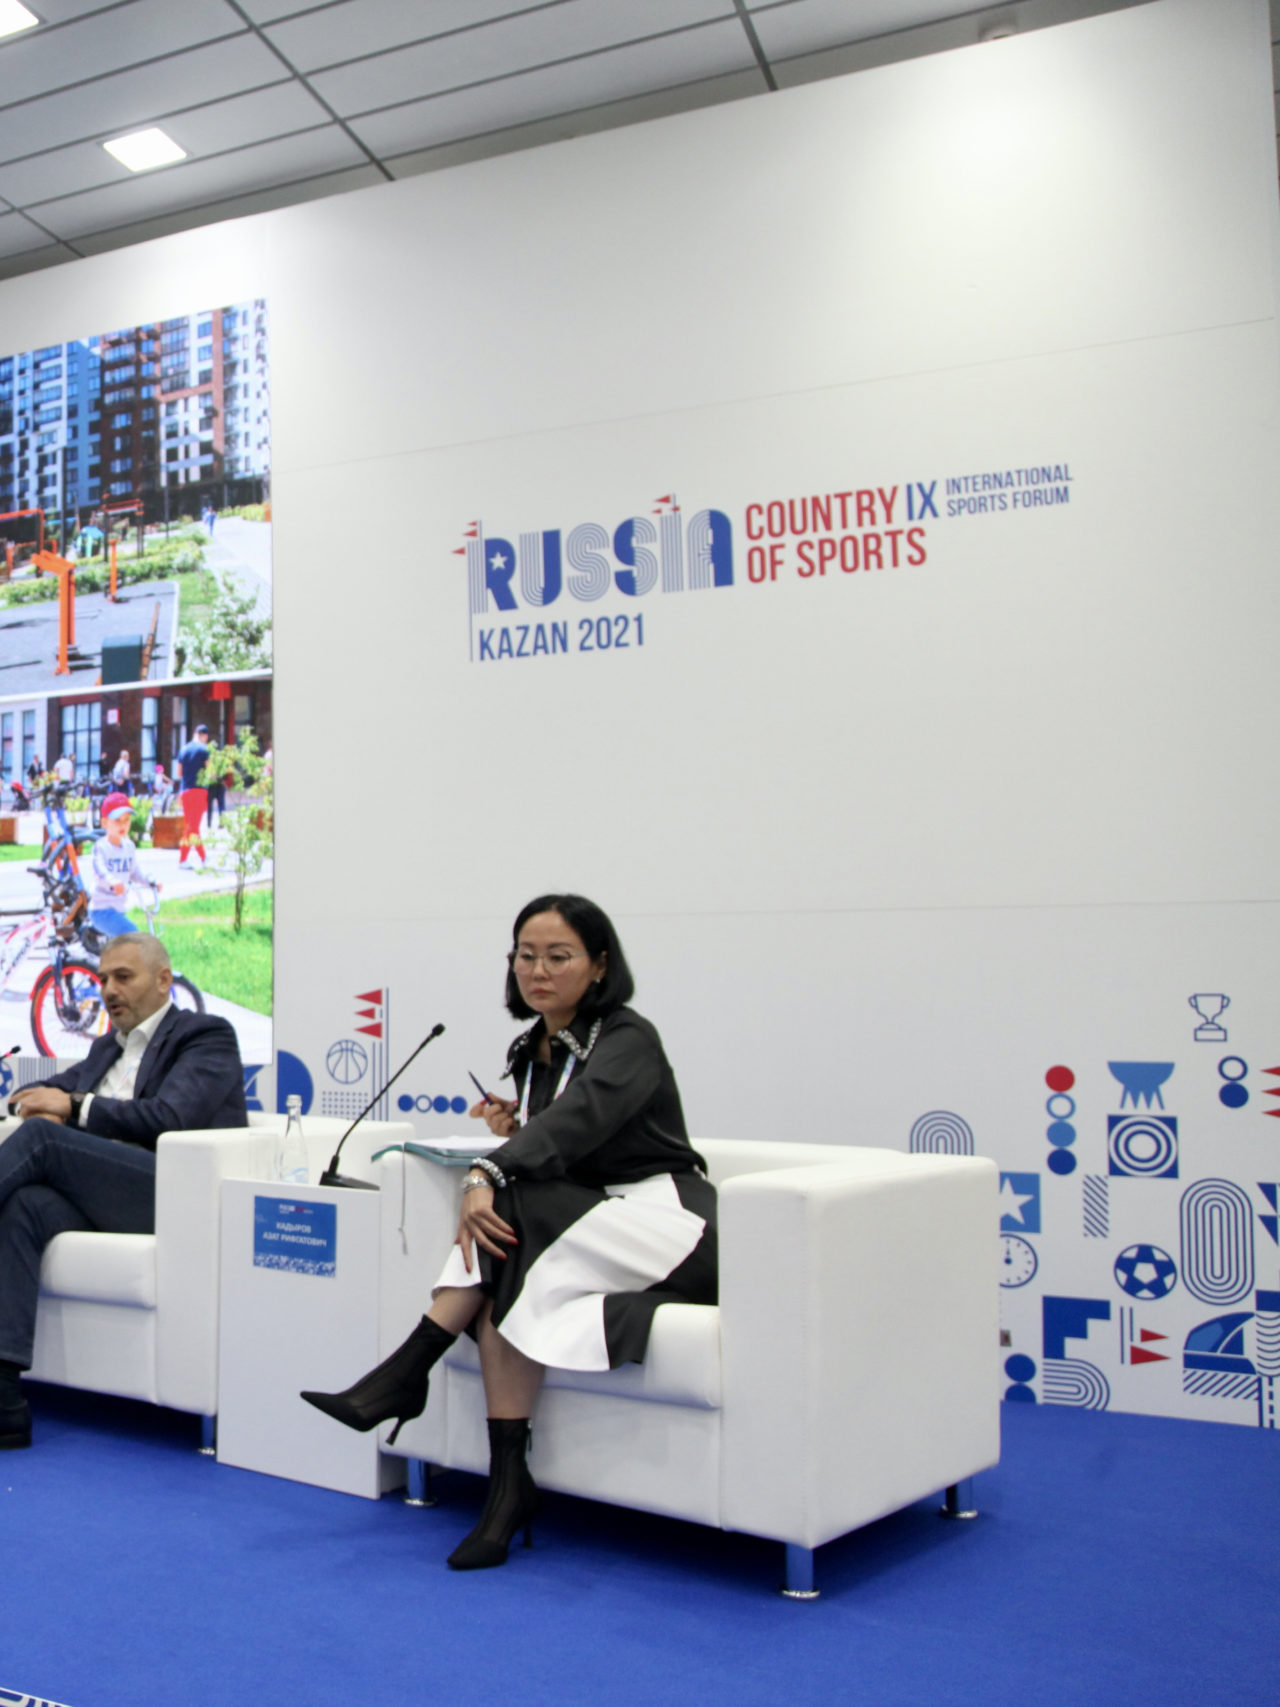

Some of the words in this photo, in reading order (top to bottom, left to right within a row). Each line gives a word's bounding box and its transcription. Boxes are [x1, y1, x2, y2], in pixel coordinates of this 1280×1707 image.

[946, 463, 1073, 496] INTERNATIONAL
[745, 485, 899, 541] COUNTRY
[906, 479, 939, 521] IX
[947, 493, 1008, 517] SPORTS
[1012, 486, 1070, 509] FORUM
[467, 507, 734, 615] RUSSIA
[747, 543, 786, 584] OF
[797, 527, 927, 578] SPORTS
[479, 621, 568, 662] KAZAN
[578, 613, 644, 651] 2021
[108, 857, 133, 872] STA
[263, 1231, 279, 1241] АЗАТ
[276, 1221, 311, 1234] КАДЫРОВ
